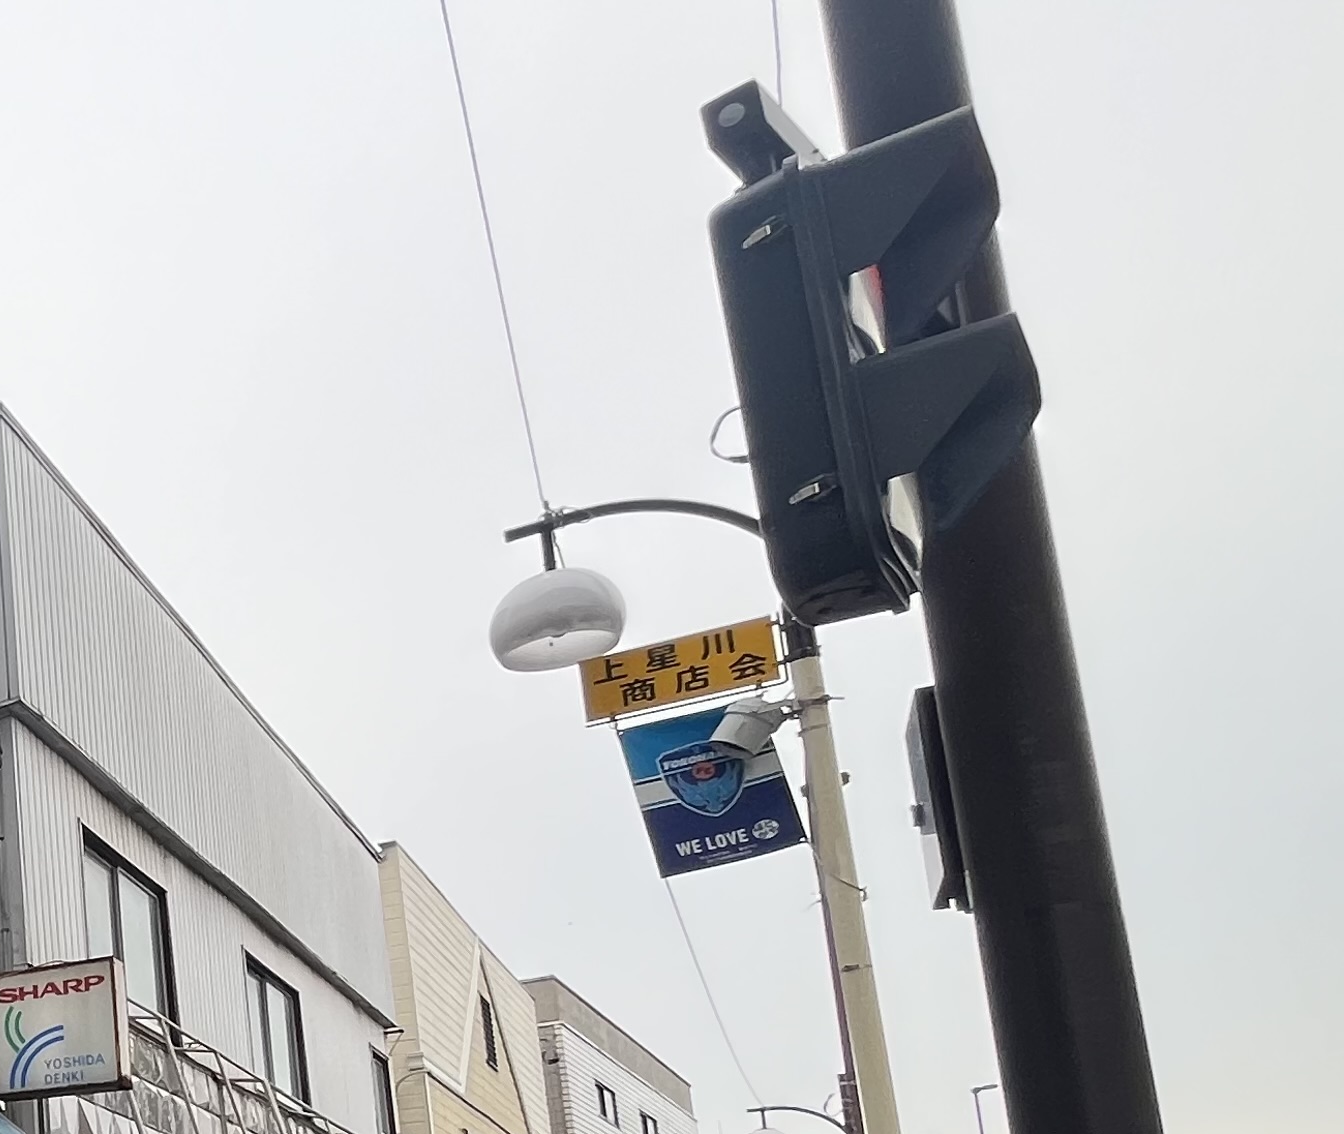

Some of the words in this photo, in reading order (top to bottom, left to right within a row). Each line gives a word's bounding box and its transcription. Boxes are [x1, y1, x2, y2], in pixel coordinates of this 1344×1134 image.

[593, 629, 736, 685] 上星川
[619, 653, 767, 707] 商店会
[675, 838, 703, 857] WE
[705, 828, 749, 851] LOVE
[44, 1053, 106, 1070] YOSHIDA
[44, 1070, 85, 1086] DENKI
